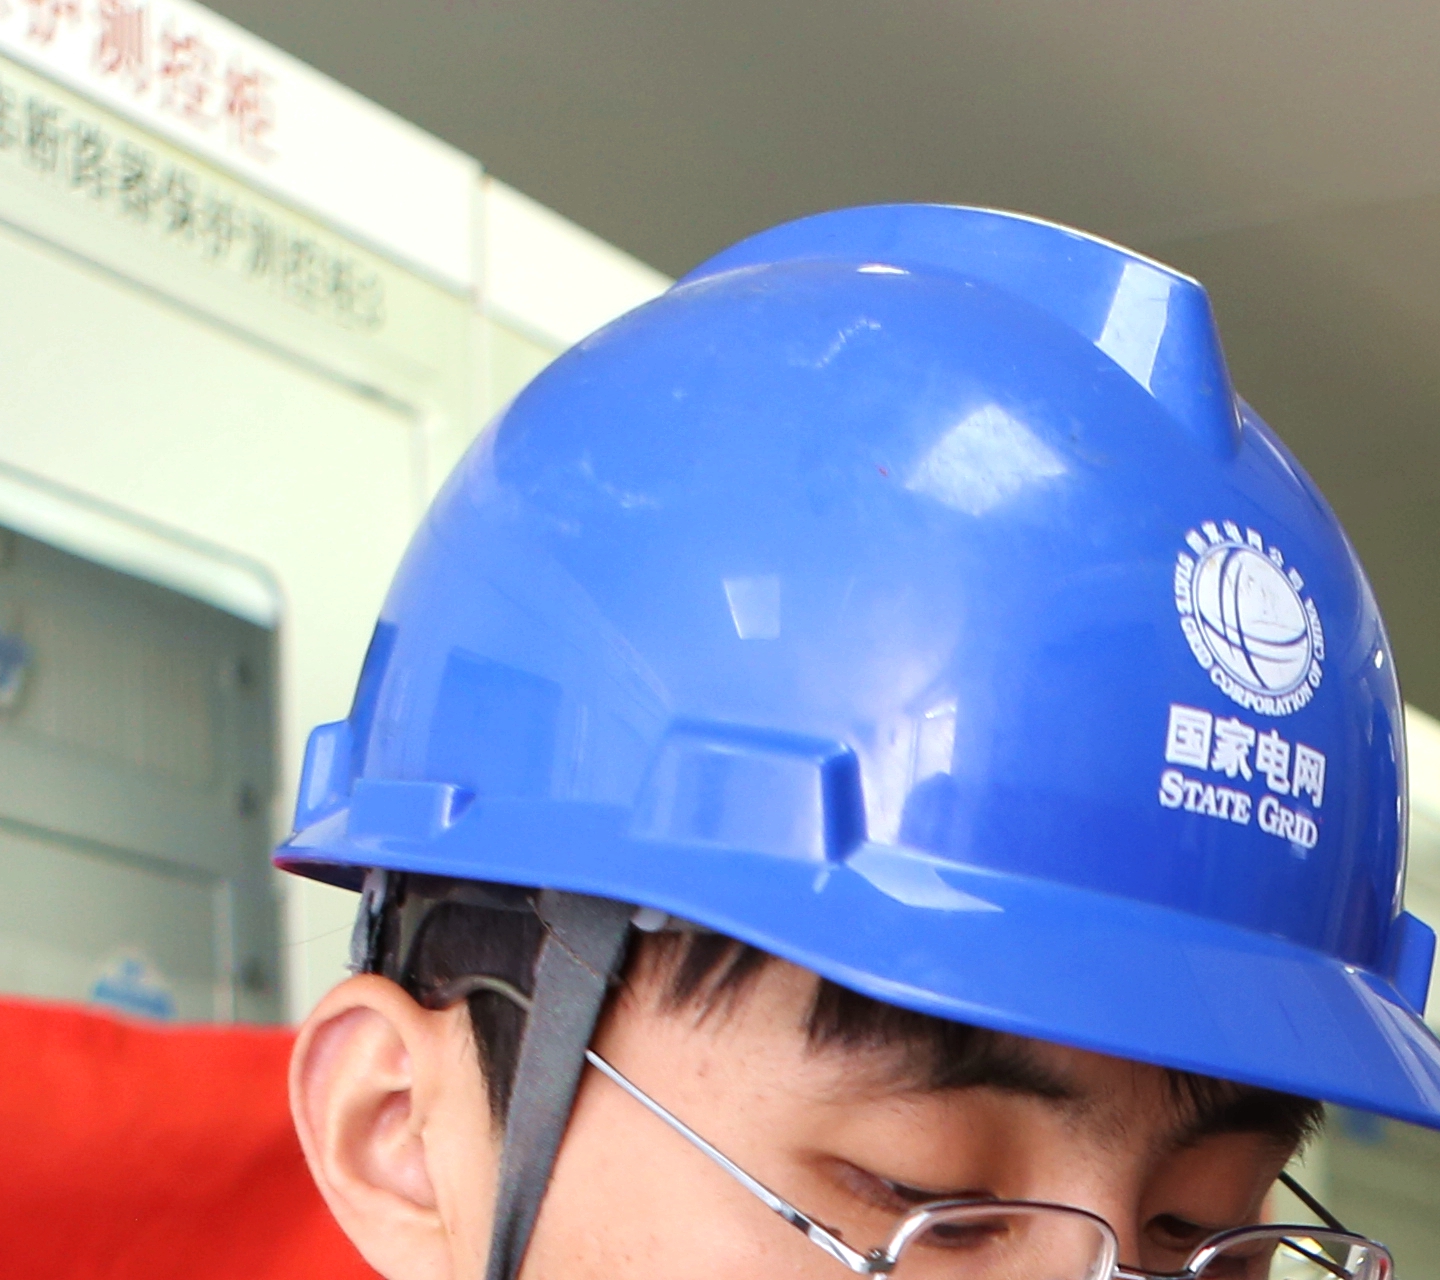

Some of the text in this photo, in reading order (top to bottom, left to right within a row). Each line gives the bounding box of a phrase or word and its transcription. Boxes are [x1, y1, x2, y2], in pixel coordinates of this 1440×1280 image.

[1164, 703, 1326, 808] 国家电网
[1159, 769, 1318, 850] STATE GRID
